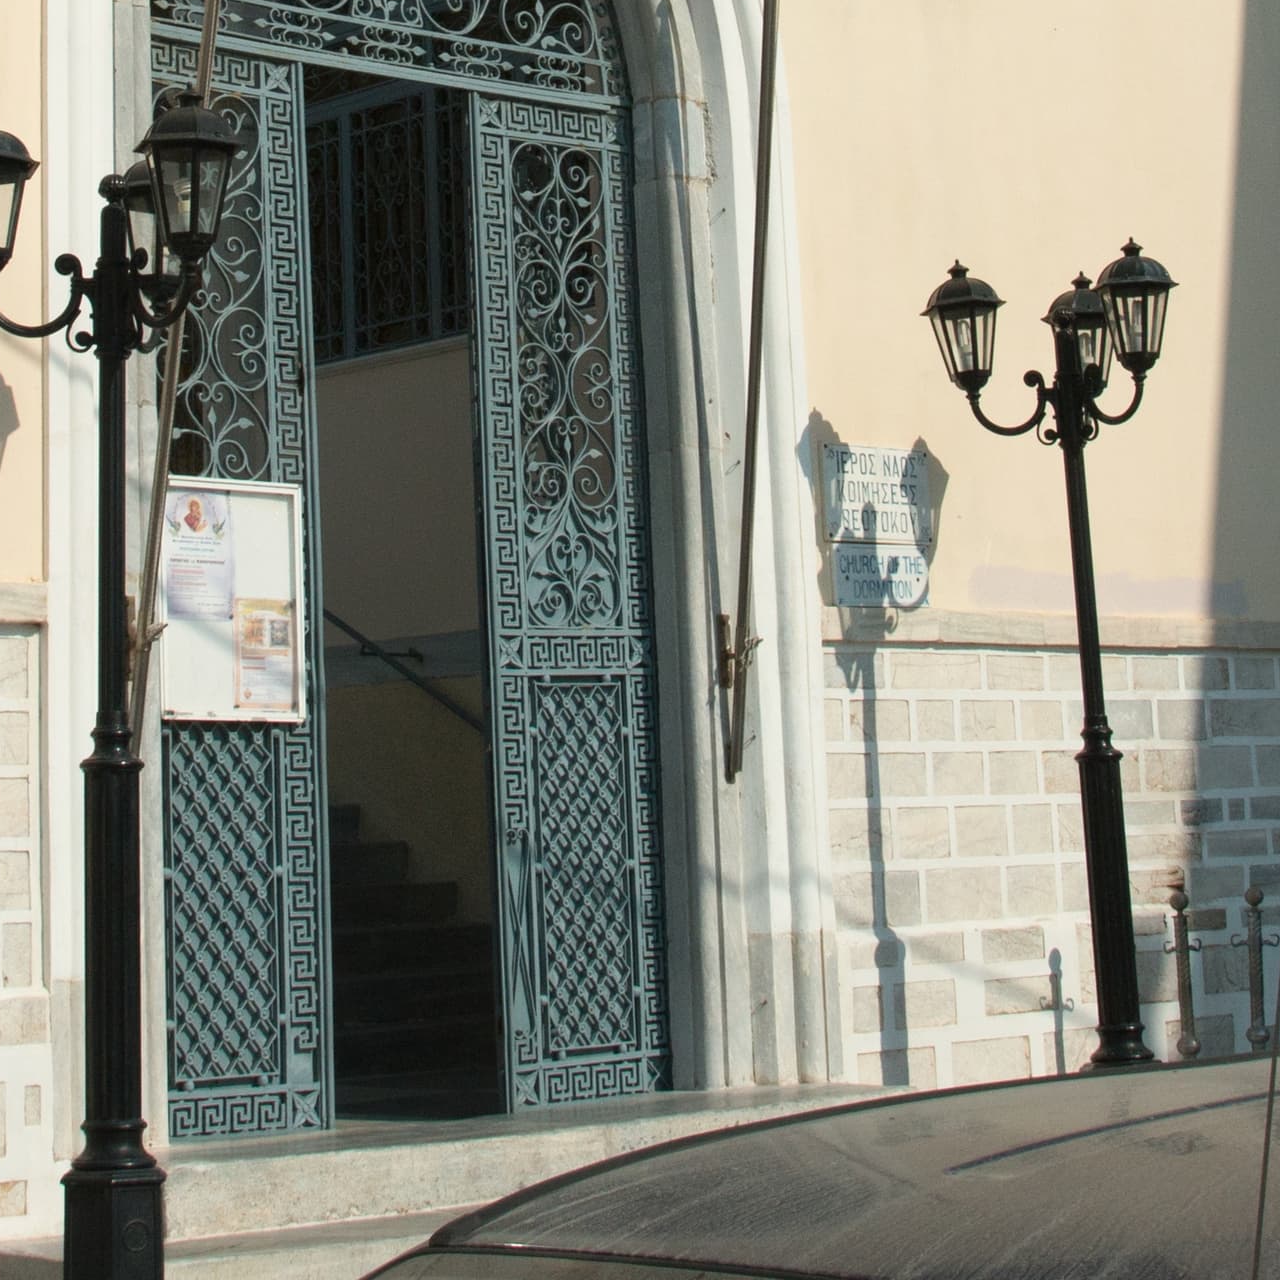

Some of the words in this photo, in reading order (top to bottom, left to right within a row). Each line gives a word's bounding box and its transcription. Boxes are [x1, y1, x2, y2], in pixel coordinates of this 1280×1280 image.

[836, 450, 877, 476] ΙΕΡΟΣ
[882, 454, 918, 479] ΝΑΟΣ
[837, 479, 918, 506] ΚΟΙΜΗΣΕΩΣ
[841, 508, 918, 535] ΘΕΟΤΟΚΟΥ
[839, 554, 884, 574] CHURCH
[888, 555, 900, 575] OF
[902, 555, 923, 575] THE
[853, 579, 913, 599] DORMITION
